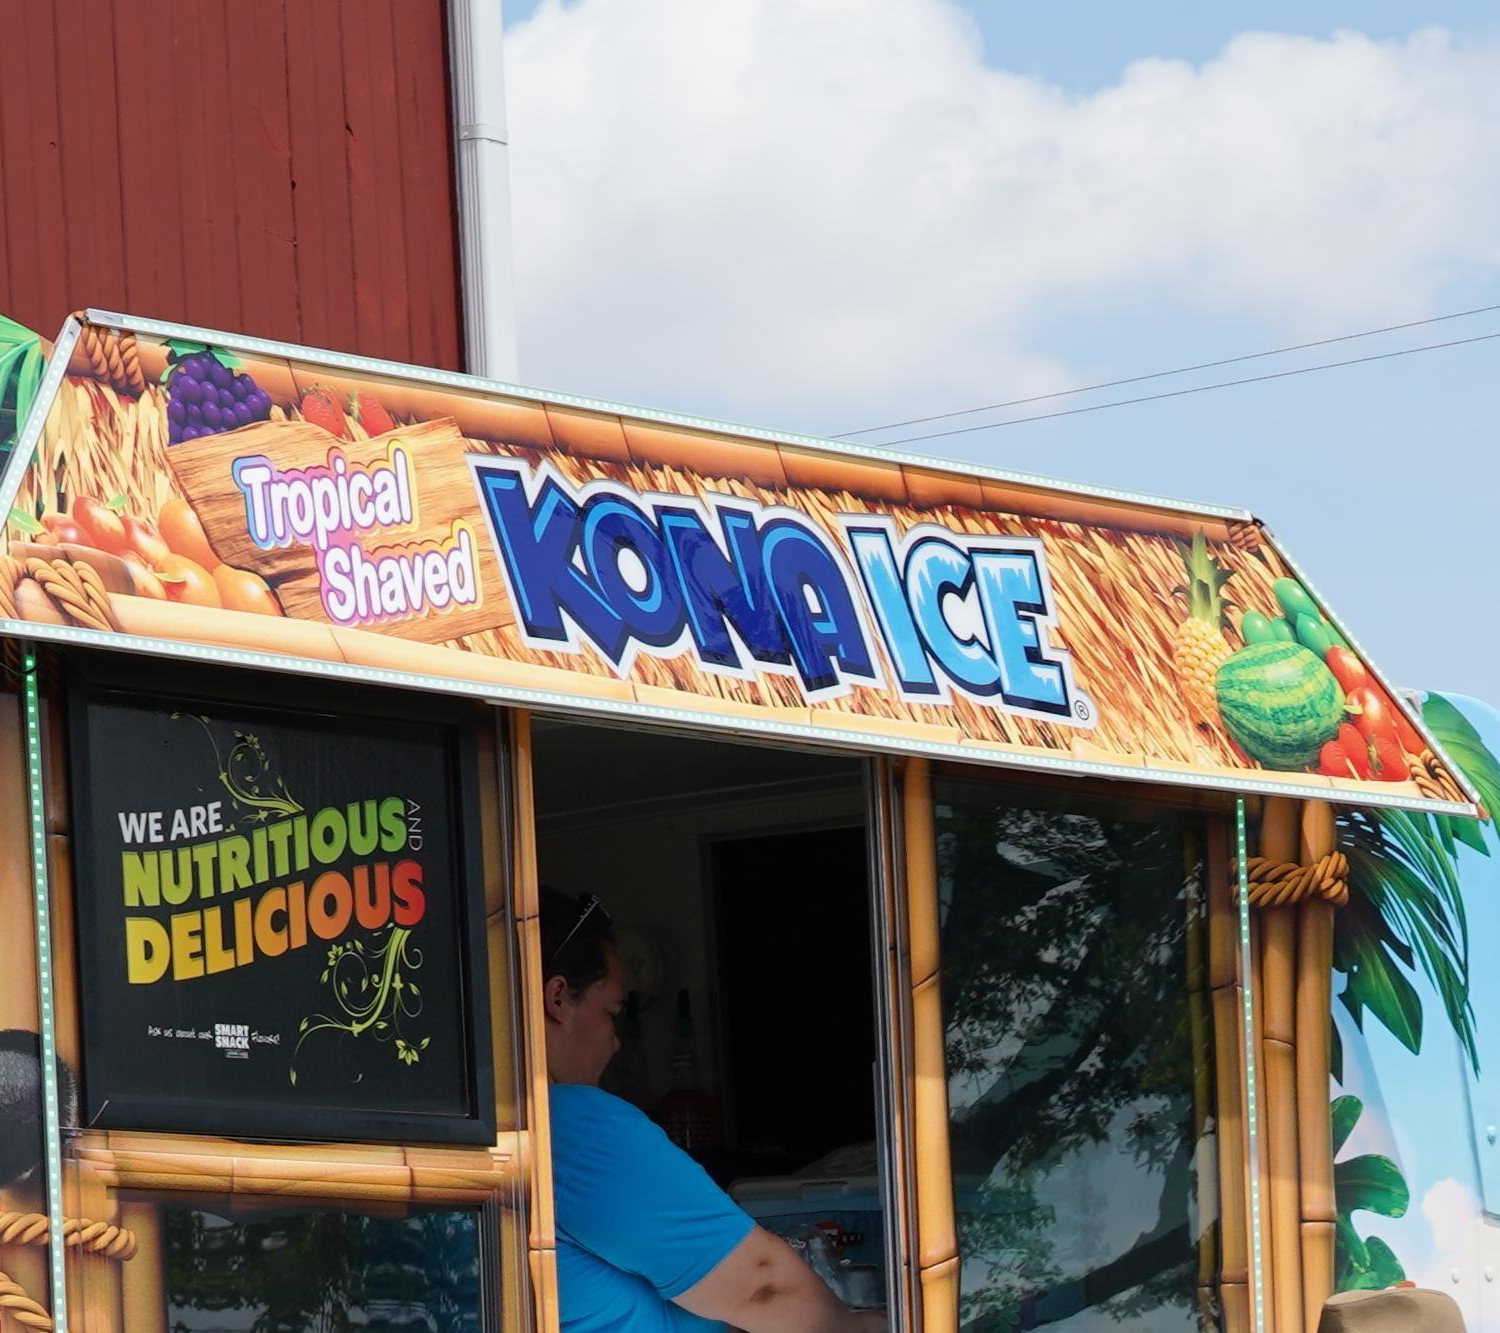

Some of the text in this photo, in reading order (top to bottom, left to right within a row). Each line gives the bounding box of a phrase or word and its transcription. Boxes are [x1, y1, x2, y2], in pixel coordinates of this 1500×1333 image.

[238, 446, 414, 551] Tropical
[323, 527, 479, 622] Shaved
[470, 460, 1075, 720] KONA ICE
[117, 800, 224, 844] WE ARE
[120, 796, 408, 907] NUTRITIOUS
[406, 798, 424, 851] AND
[124, 858, 426, 985] DELICIOUS
[214, 1023, 249, 1037] SMART
[215, 1036, 250, 1049] SNACK
